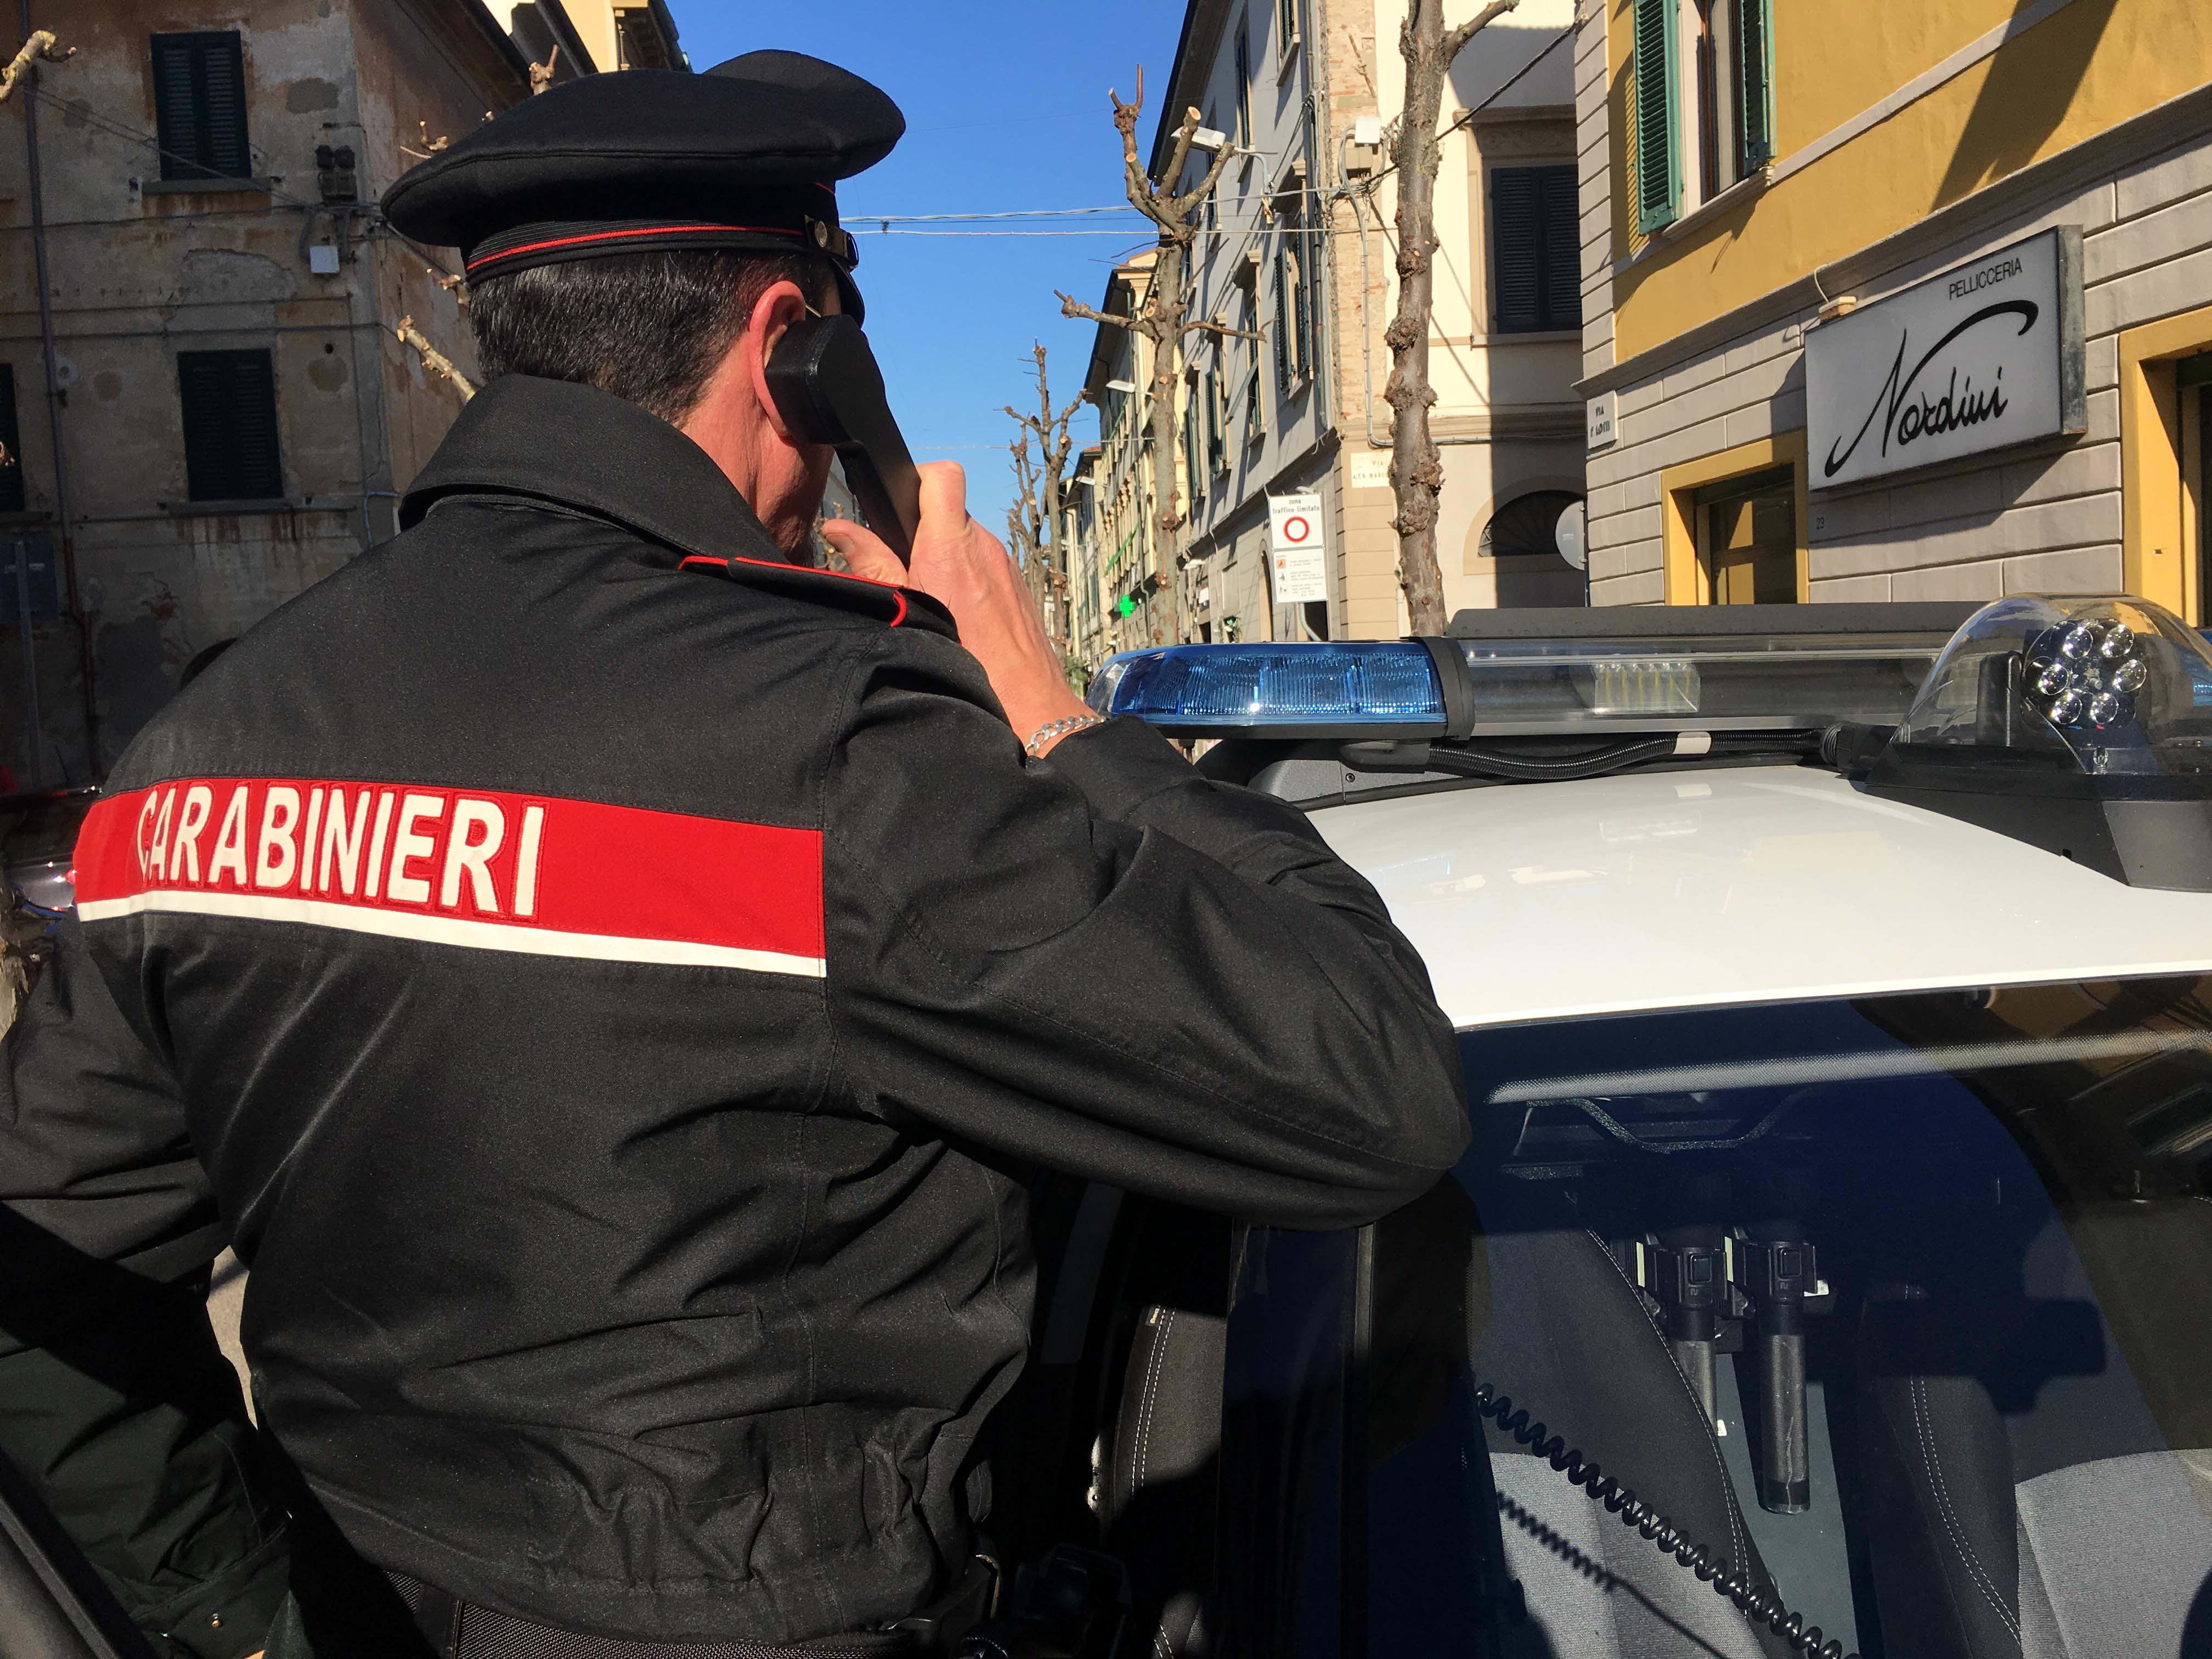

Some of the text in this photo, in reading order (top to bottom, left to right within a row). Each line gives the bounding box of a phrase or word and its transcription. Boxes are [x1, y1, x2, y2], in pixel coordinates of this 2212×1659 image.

[1949, 258, 2023, 301] PELLICCERIA
[1824, 300, 2039, 477] Nordini
[136, 785, 544, 917] CARABINIERI
